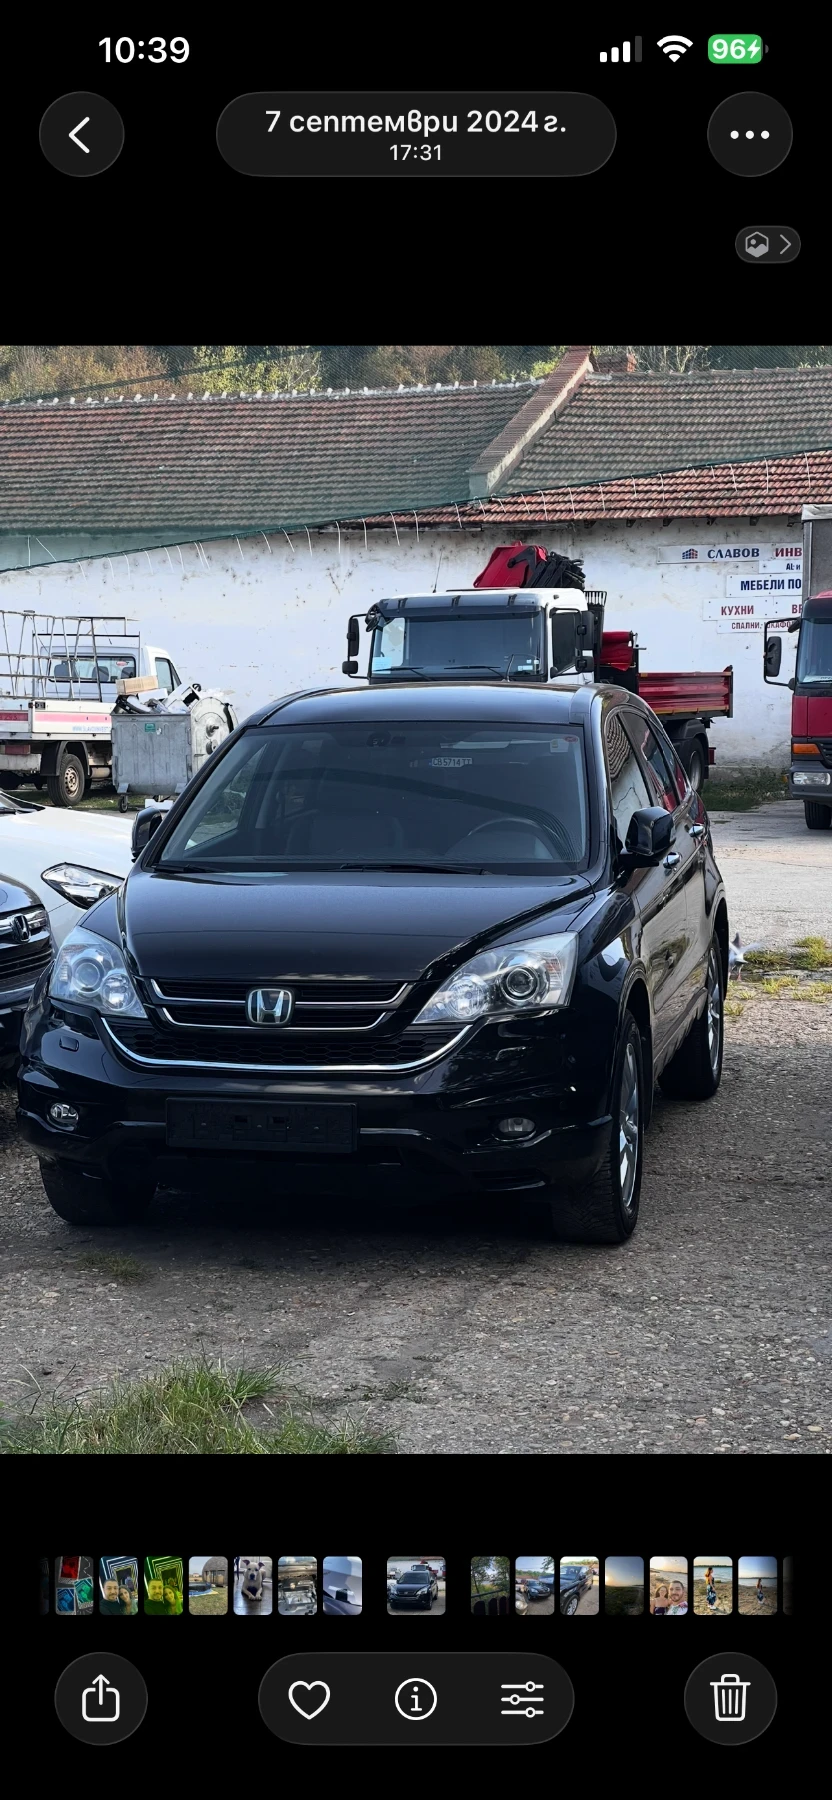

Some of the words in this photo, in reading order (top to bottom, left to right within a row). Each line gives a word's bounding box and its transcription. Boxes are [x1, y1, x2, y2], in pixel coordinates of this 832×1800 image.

[707, 548, 760, 559] СЛАВОВ
[775, 547, 802, 557] ИНВ
[740, 579, 784, 591] МЕБЕЛИ
[788, 579, 802, 589] ПО
[721, 605, 754, 616] КУХНИ
